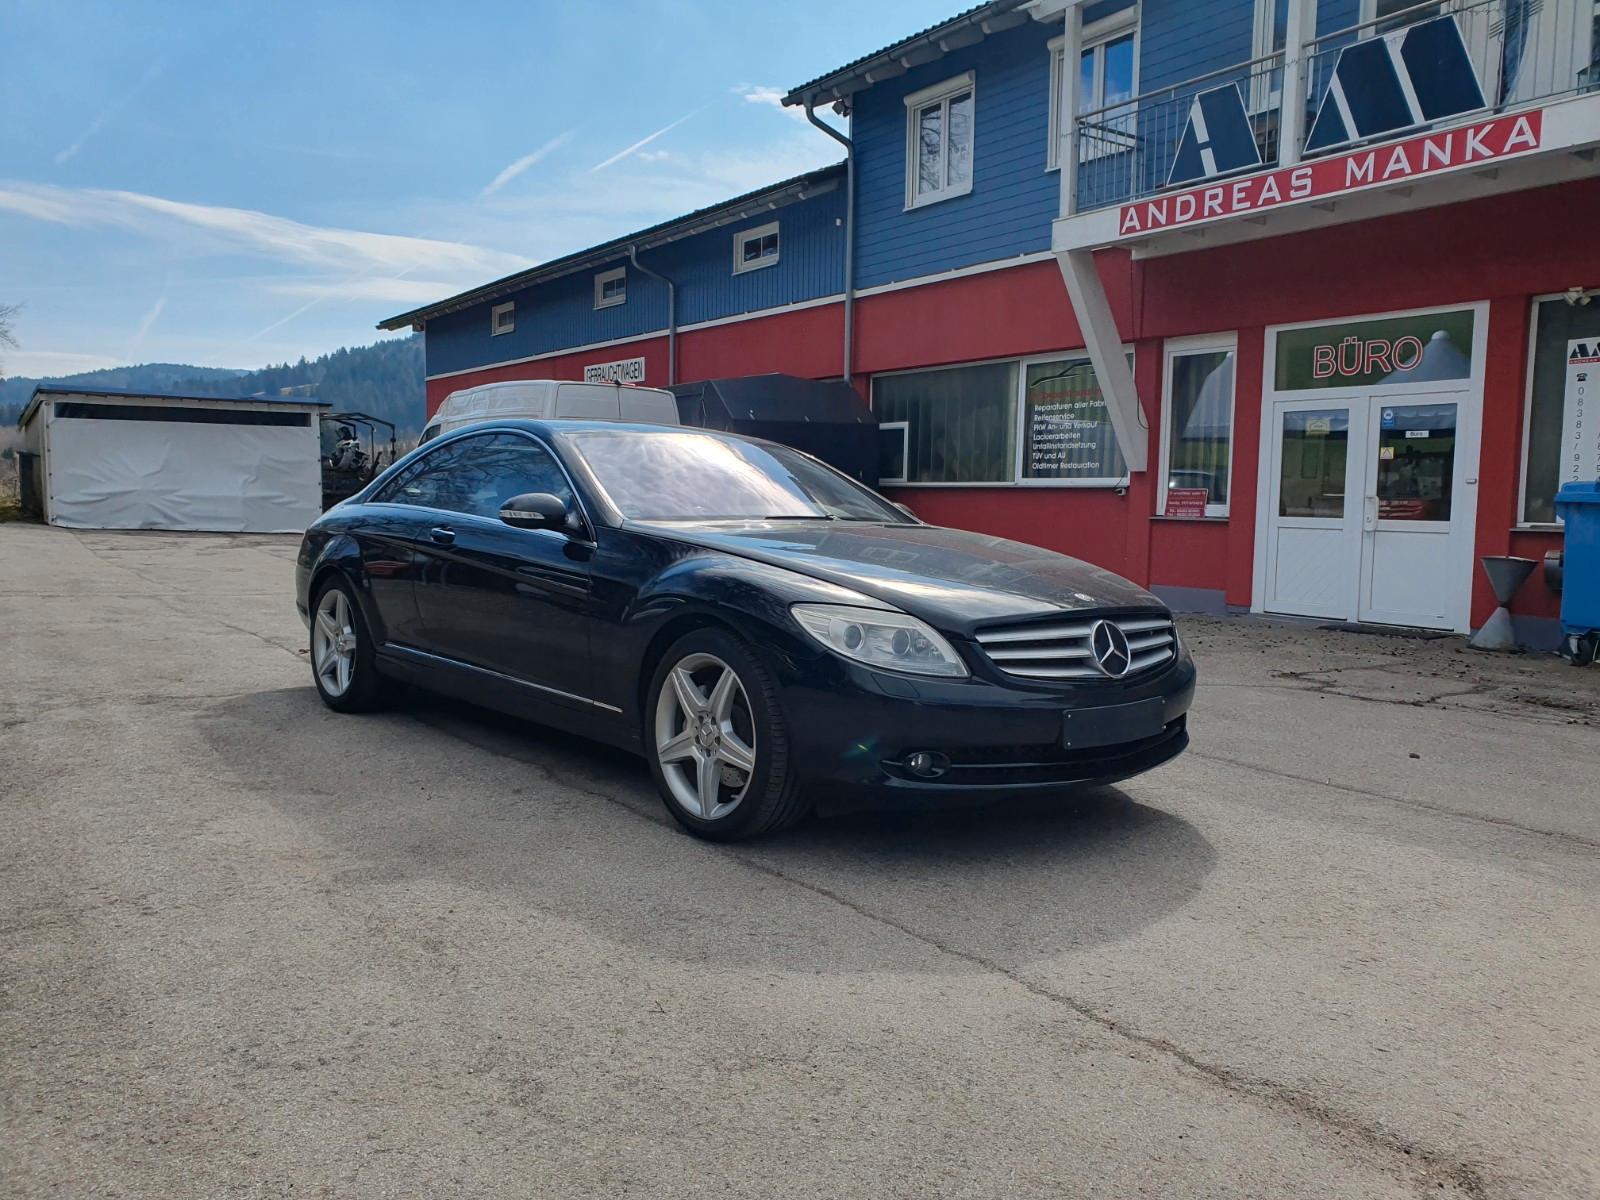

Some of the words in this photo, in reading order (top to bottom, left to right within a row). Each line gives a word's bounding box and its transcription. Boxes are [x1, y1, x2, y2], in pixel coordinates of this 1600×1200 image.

[1121, 168, 1312, 233] ANDREAS
[1345, 116, 1538, 187] MANKA
[1313, 336, 1423, 378] BÜRO
[1059, 422, 1073, 430] und
[1043, 451, 1057, 460] und
